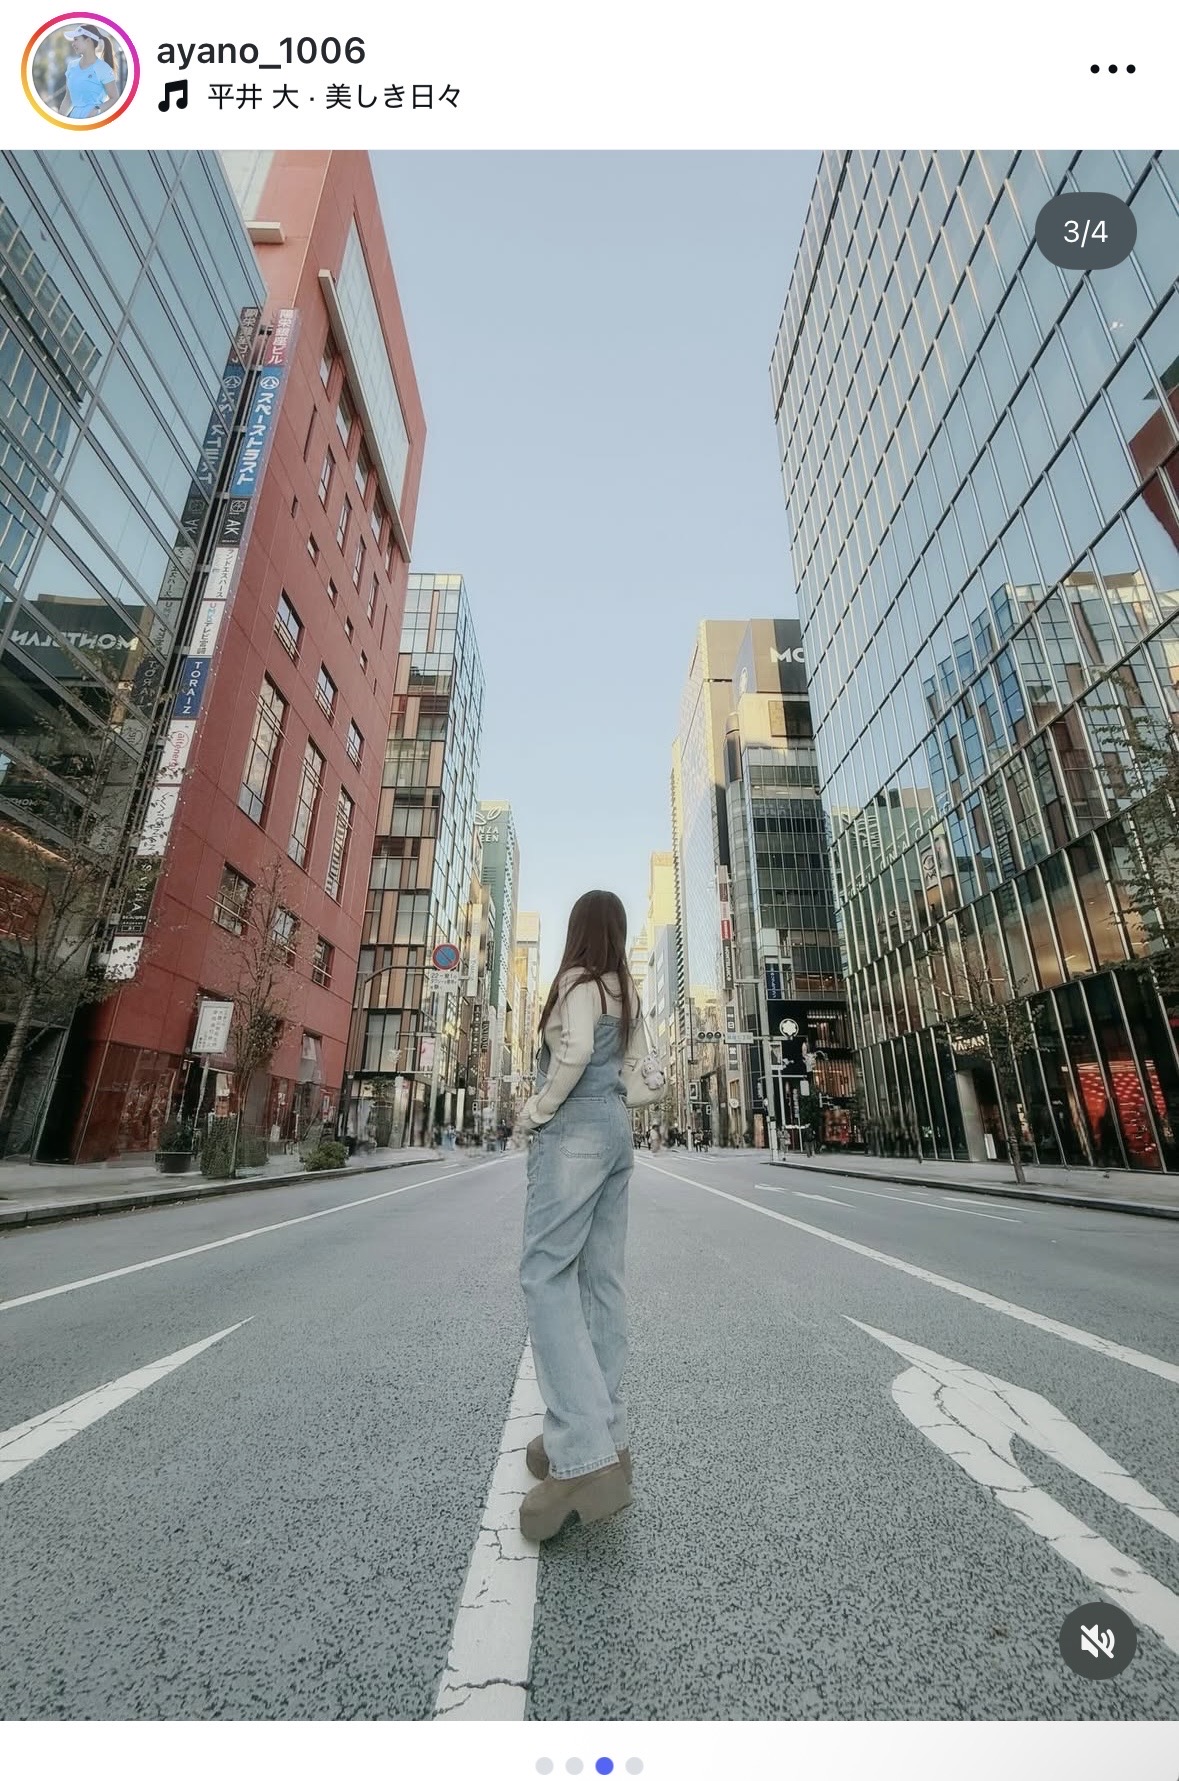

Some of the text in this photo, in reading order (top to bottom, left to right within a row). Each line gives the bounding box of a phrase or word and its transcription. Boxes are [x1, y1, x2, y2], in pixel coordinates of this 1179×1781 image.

[236, 392, 275, 485] スペーストラスト
[224, 519, 241, 535] AK
[182, 661, 203, 714] TORAIZ
